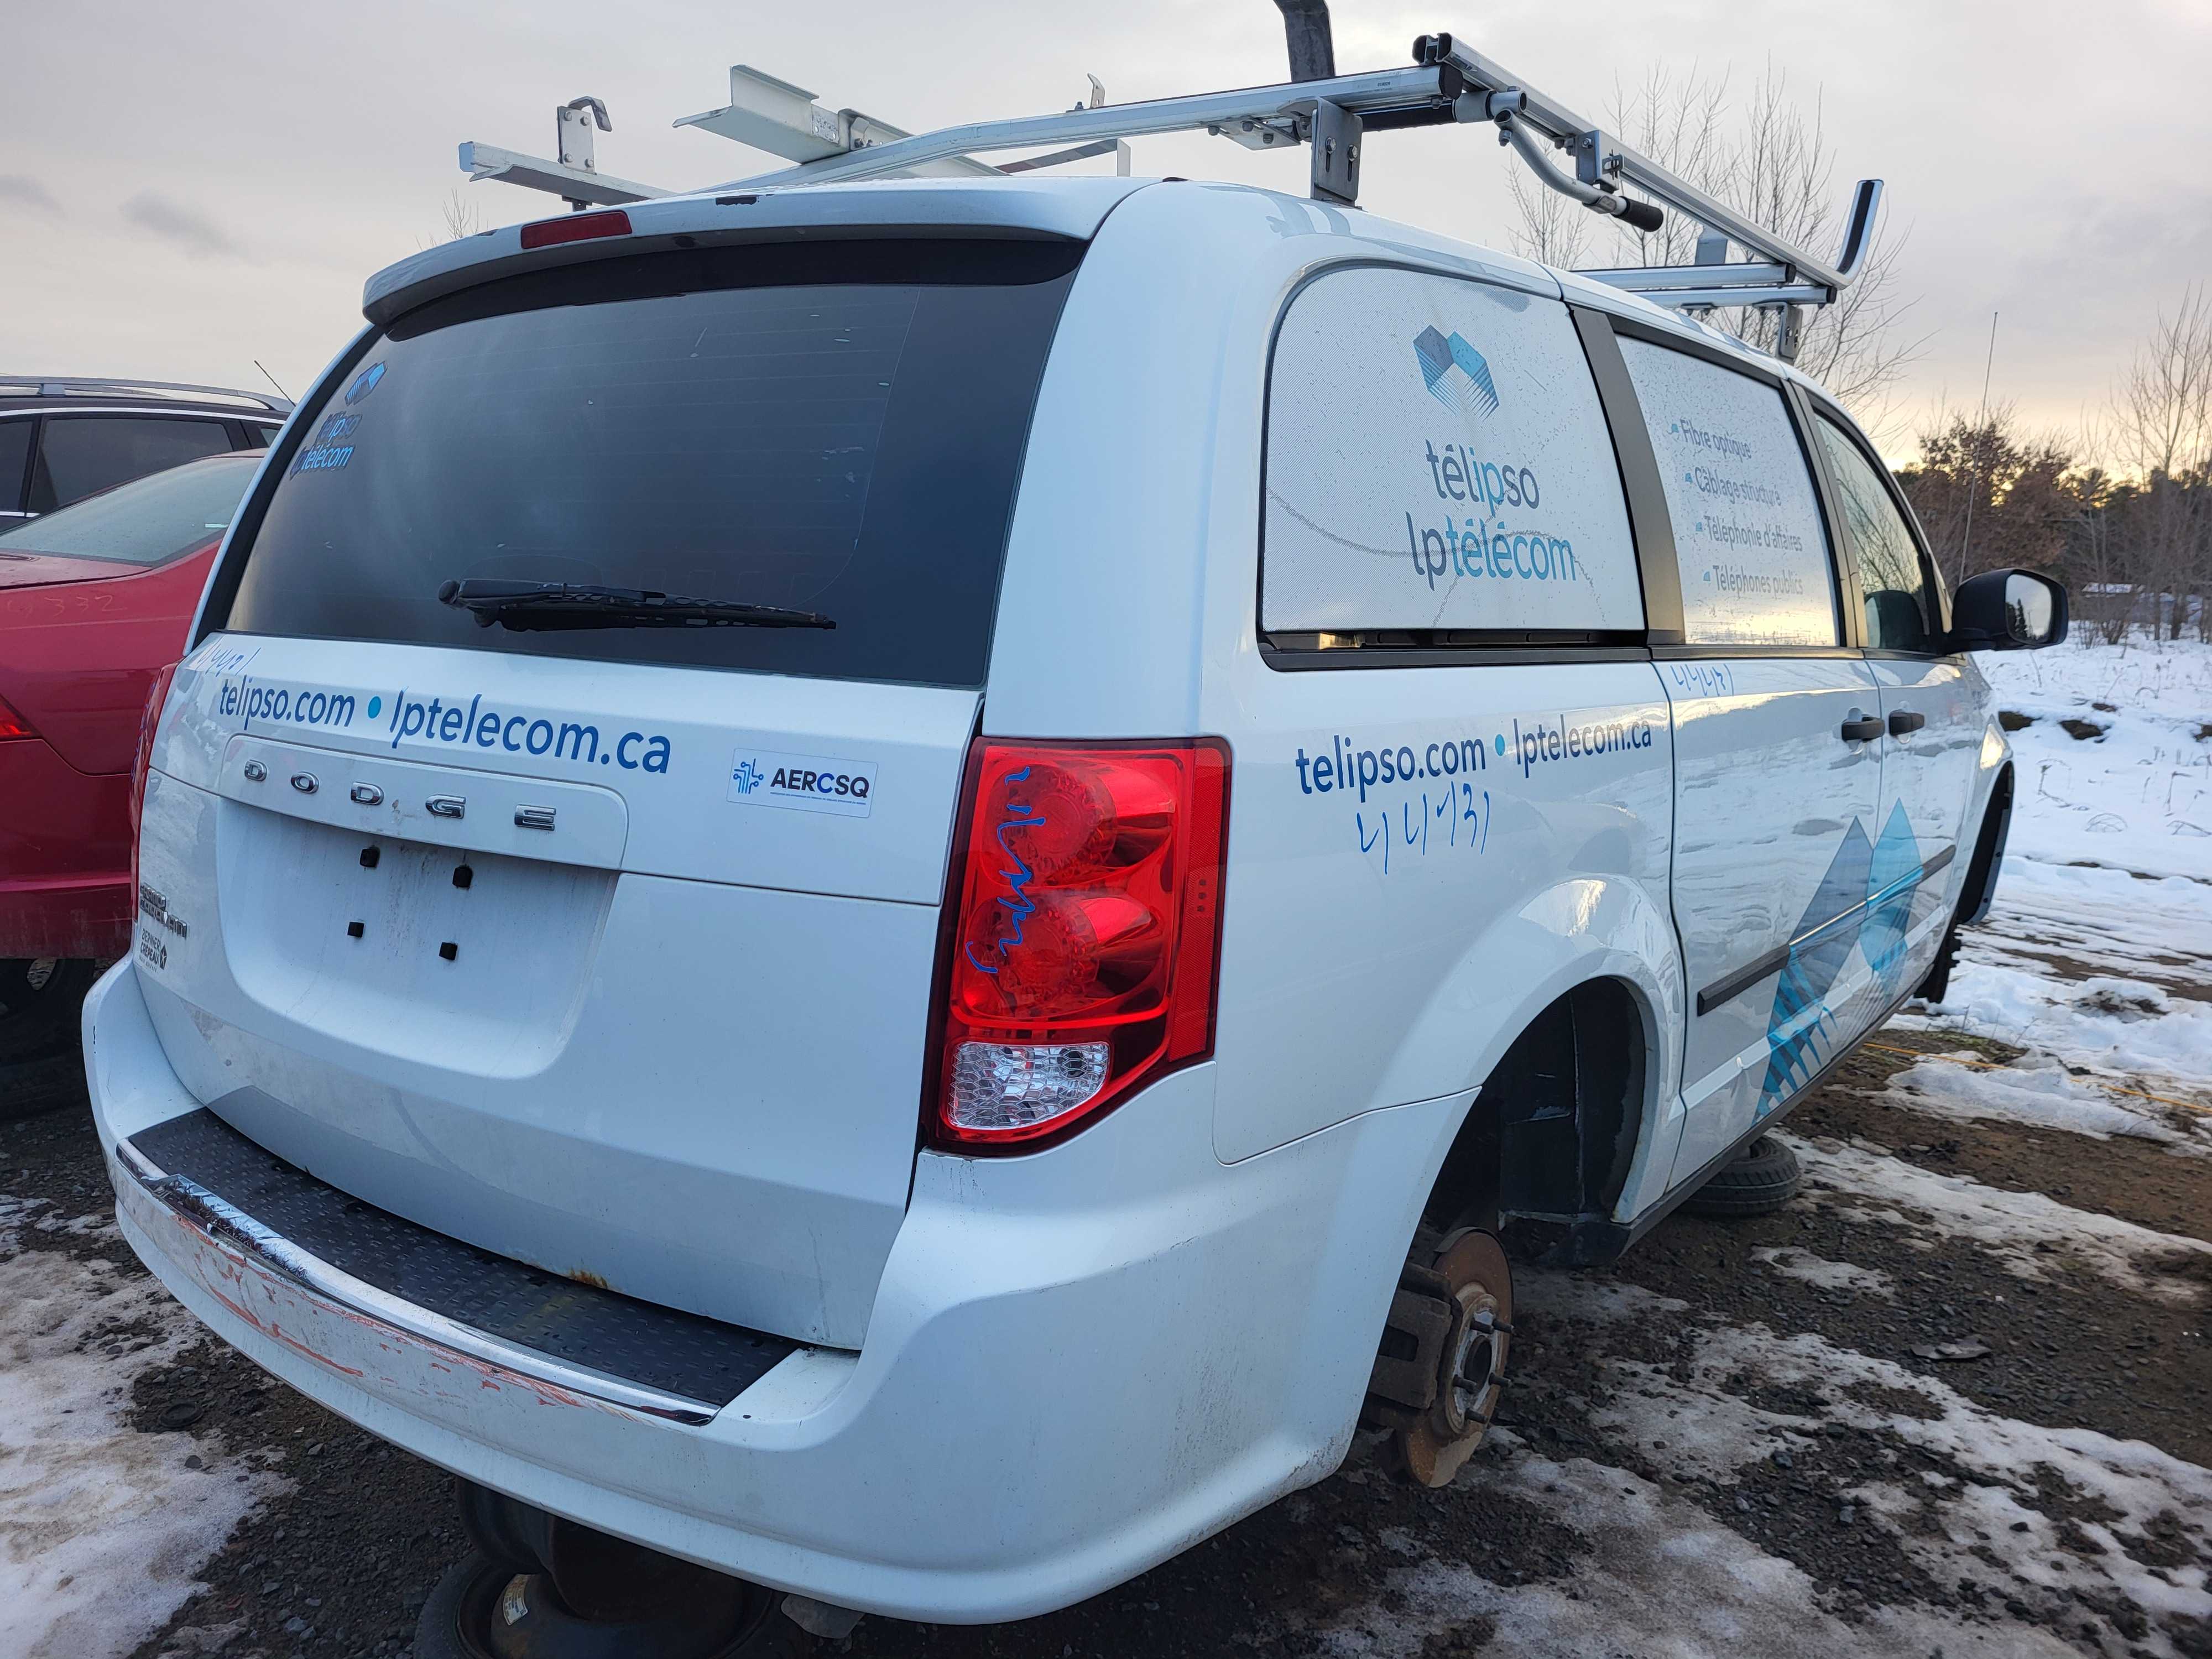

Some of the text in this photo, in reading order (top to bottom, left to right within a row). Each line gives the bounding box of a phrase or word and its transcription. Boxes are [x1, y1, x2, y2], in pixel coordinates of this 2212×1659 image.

[1680, 419, 1752, 463] Fibre optique
[1425, 439, 1540, 518] télipso
[1405, 510, 1577, 592] lptélécom
[1704, 515, 1762, 551] Téléphonie
[1712, 564, 1771, 599] Téléphones
[219, 674, 671, 774] telipso.com lptelecom.ca
[1296, 713, 1652, 803] telipso.com lptelecom.ca
[244, 759, 556, 831] DODGE
[770, 768, 869, 799] AERCSQ
